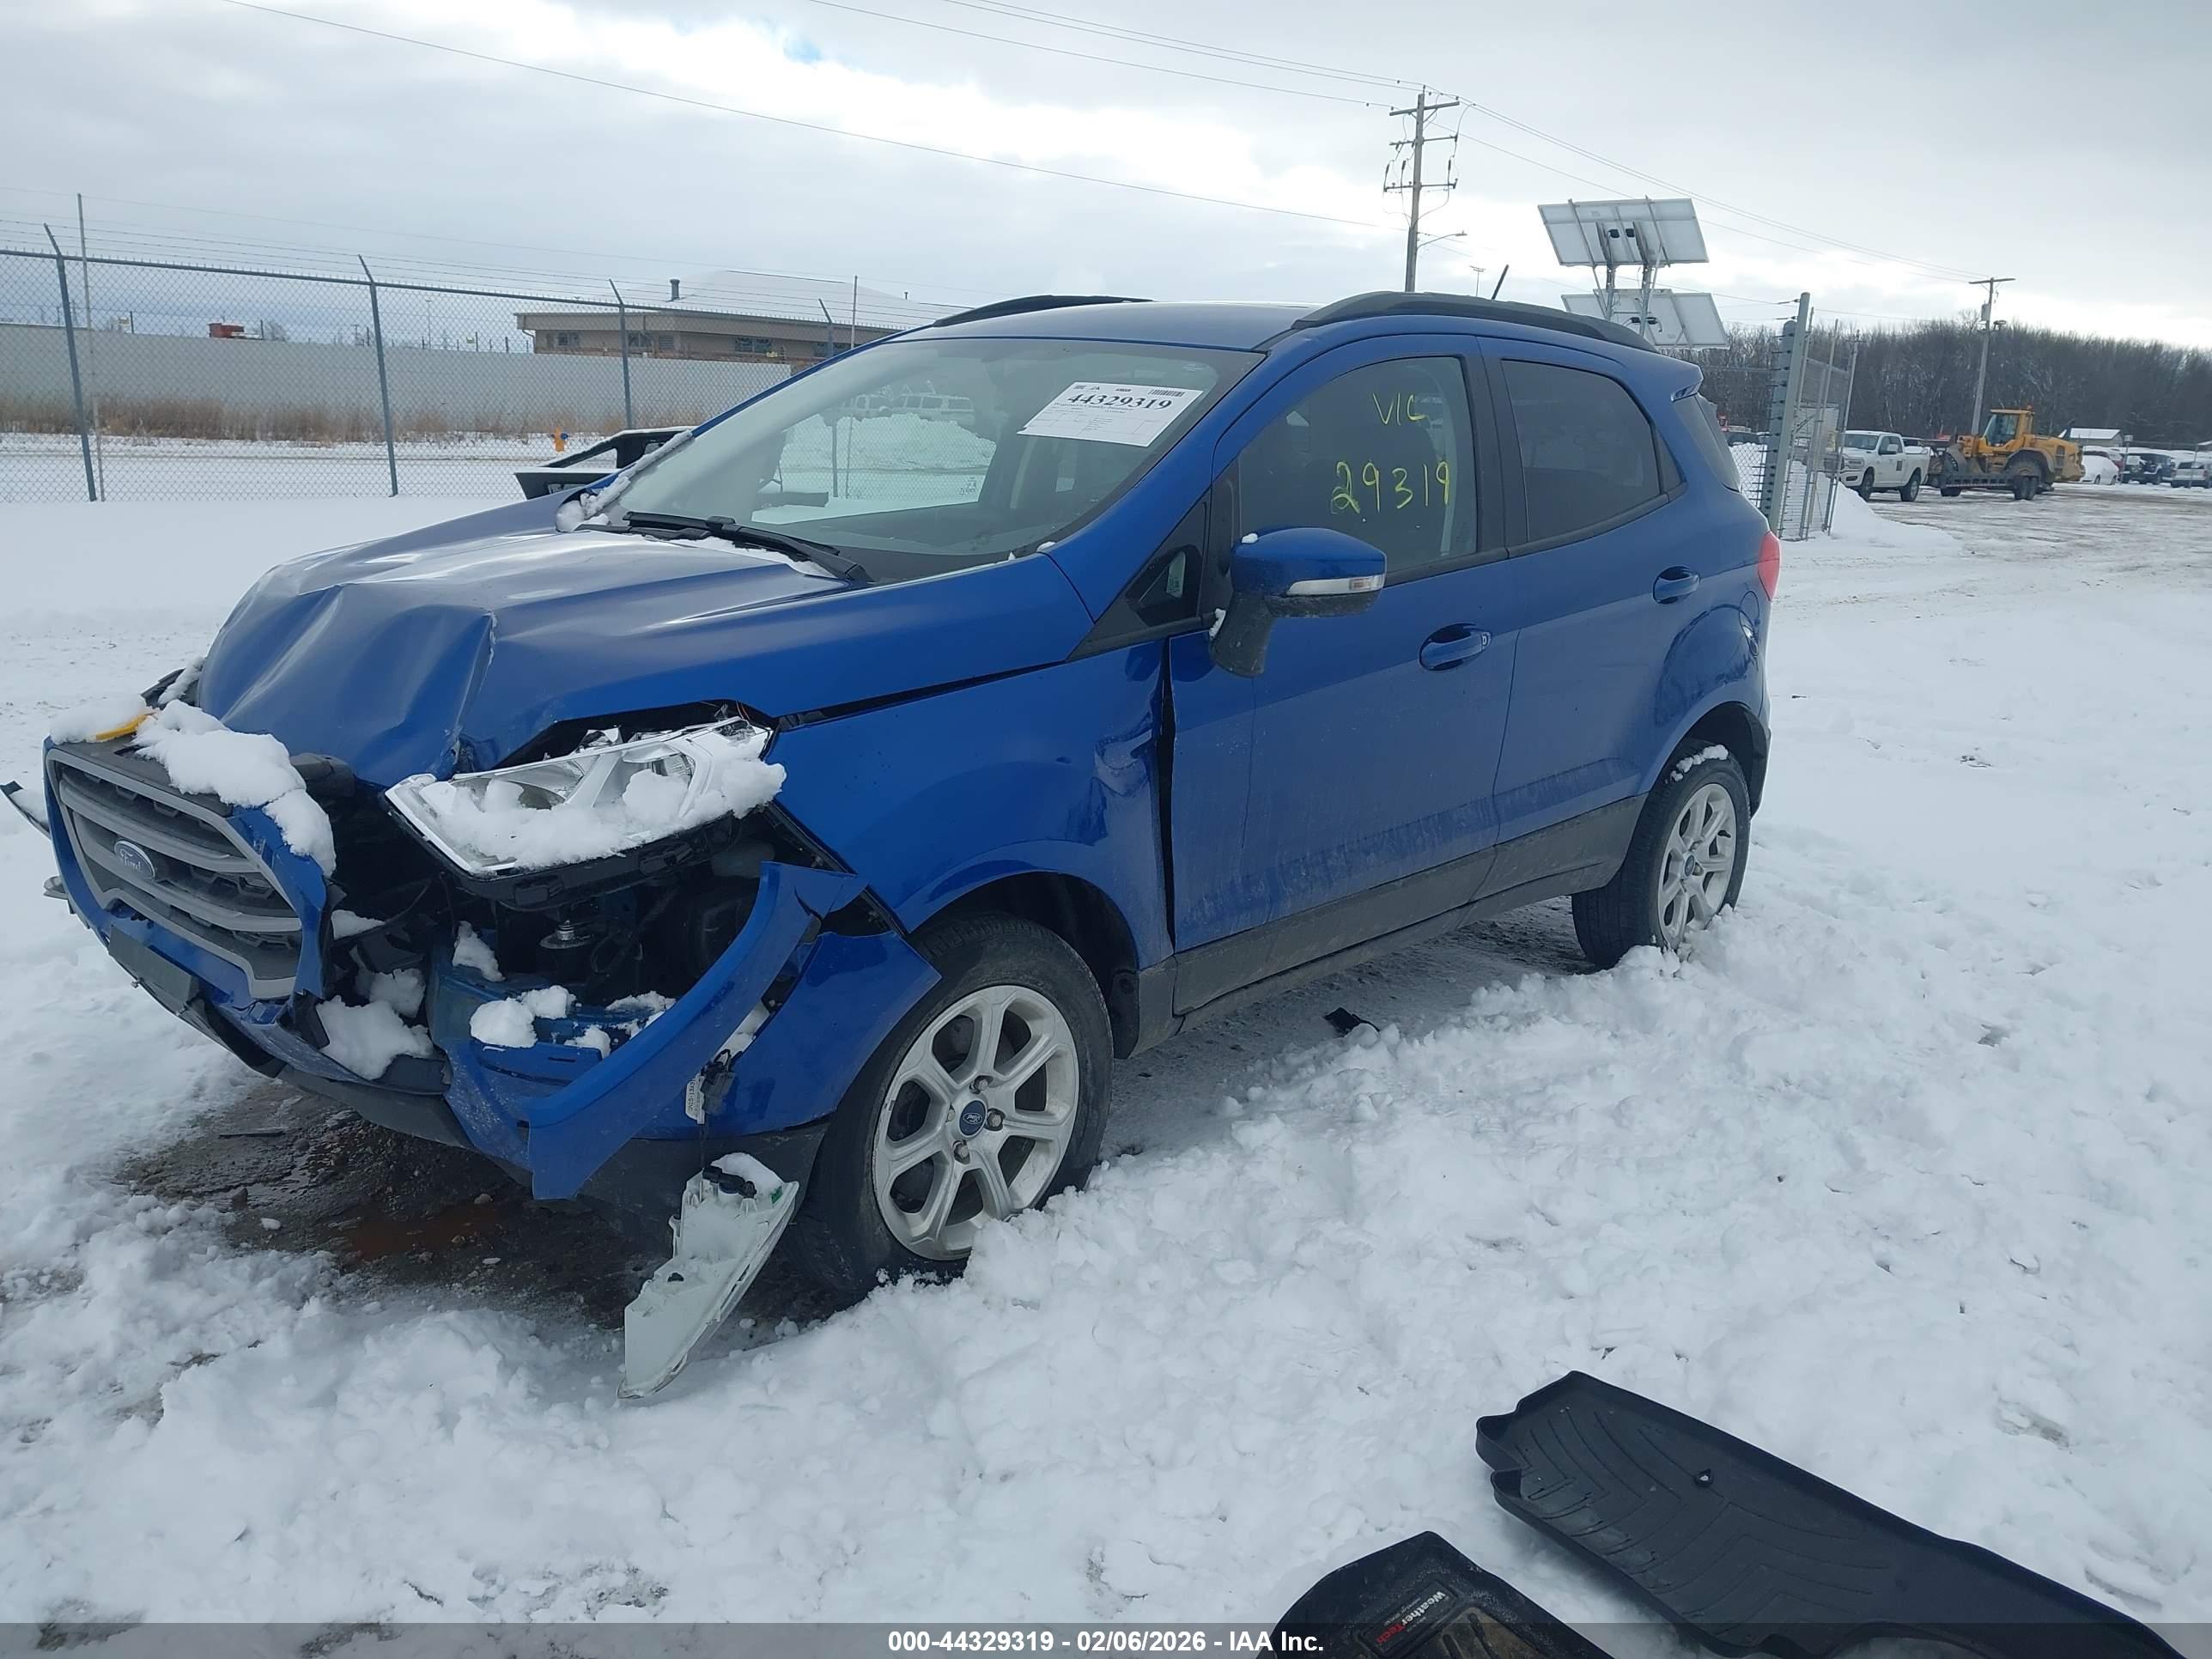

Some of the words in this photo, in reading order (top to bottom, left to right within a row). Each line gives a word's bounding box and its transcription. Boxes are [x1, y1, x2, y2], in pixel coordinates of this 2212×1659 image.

[1066, 393, 1173, 410] 44329319
[1330, 460, 1450, 514] 29319
[1376, 1591, 1446, 1644] WeatherTech
